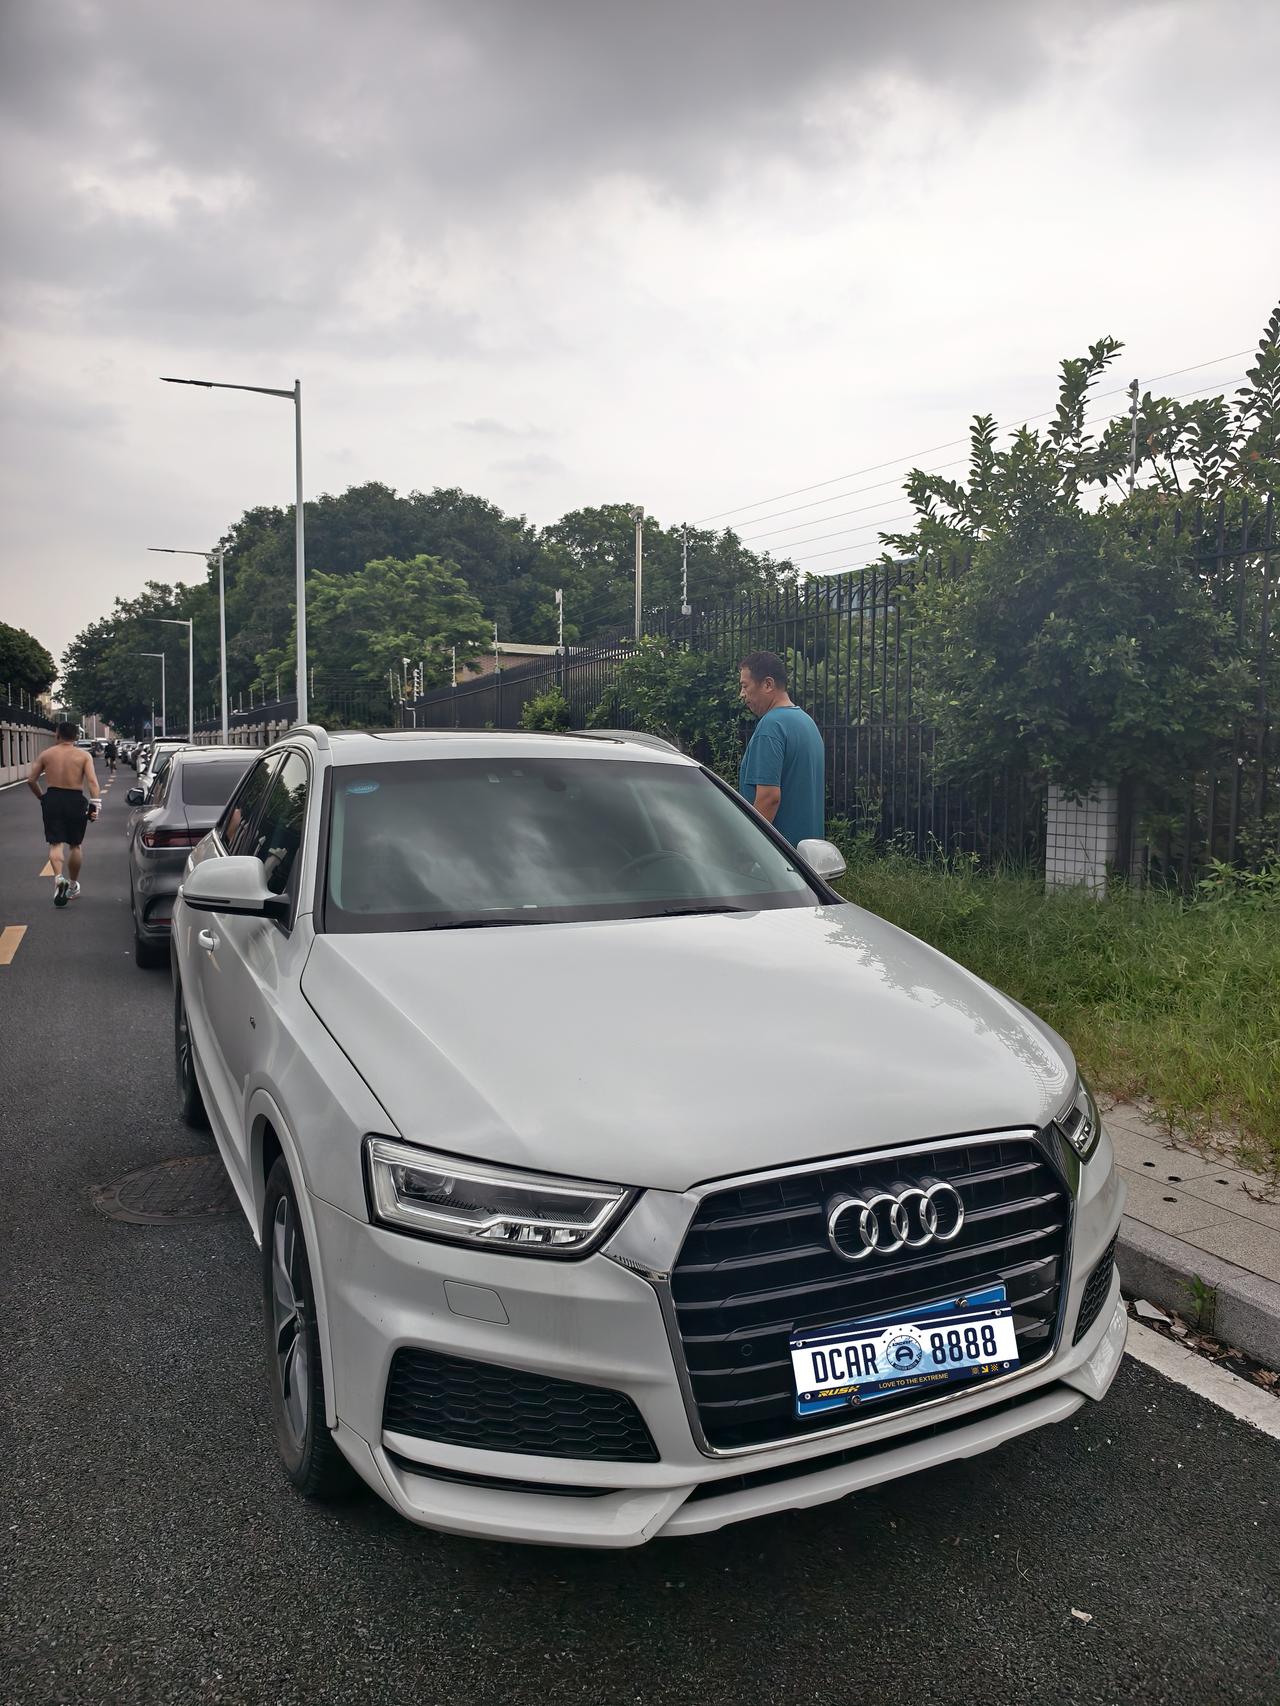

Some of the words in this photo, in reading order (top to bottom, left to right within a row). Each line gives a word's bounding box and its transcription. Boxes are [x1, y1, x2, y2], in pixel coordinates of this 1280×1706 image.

[811, 1343, 879, 1383] DCAR
[930, 1325, 997, 1364] 8888
[879, 1381, 896, 1389] LOVE
[906, 1377, 919, 1385] THE
[919, 1372, 949, 1383] EXTREME
